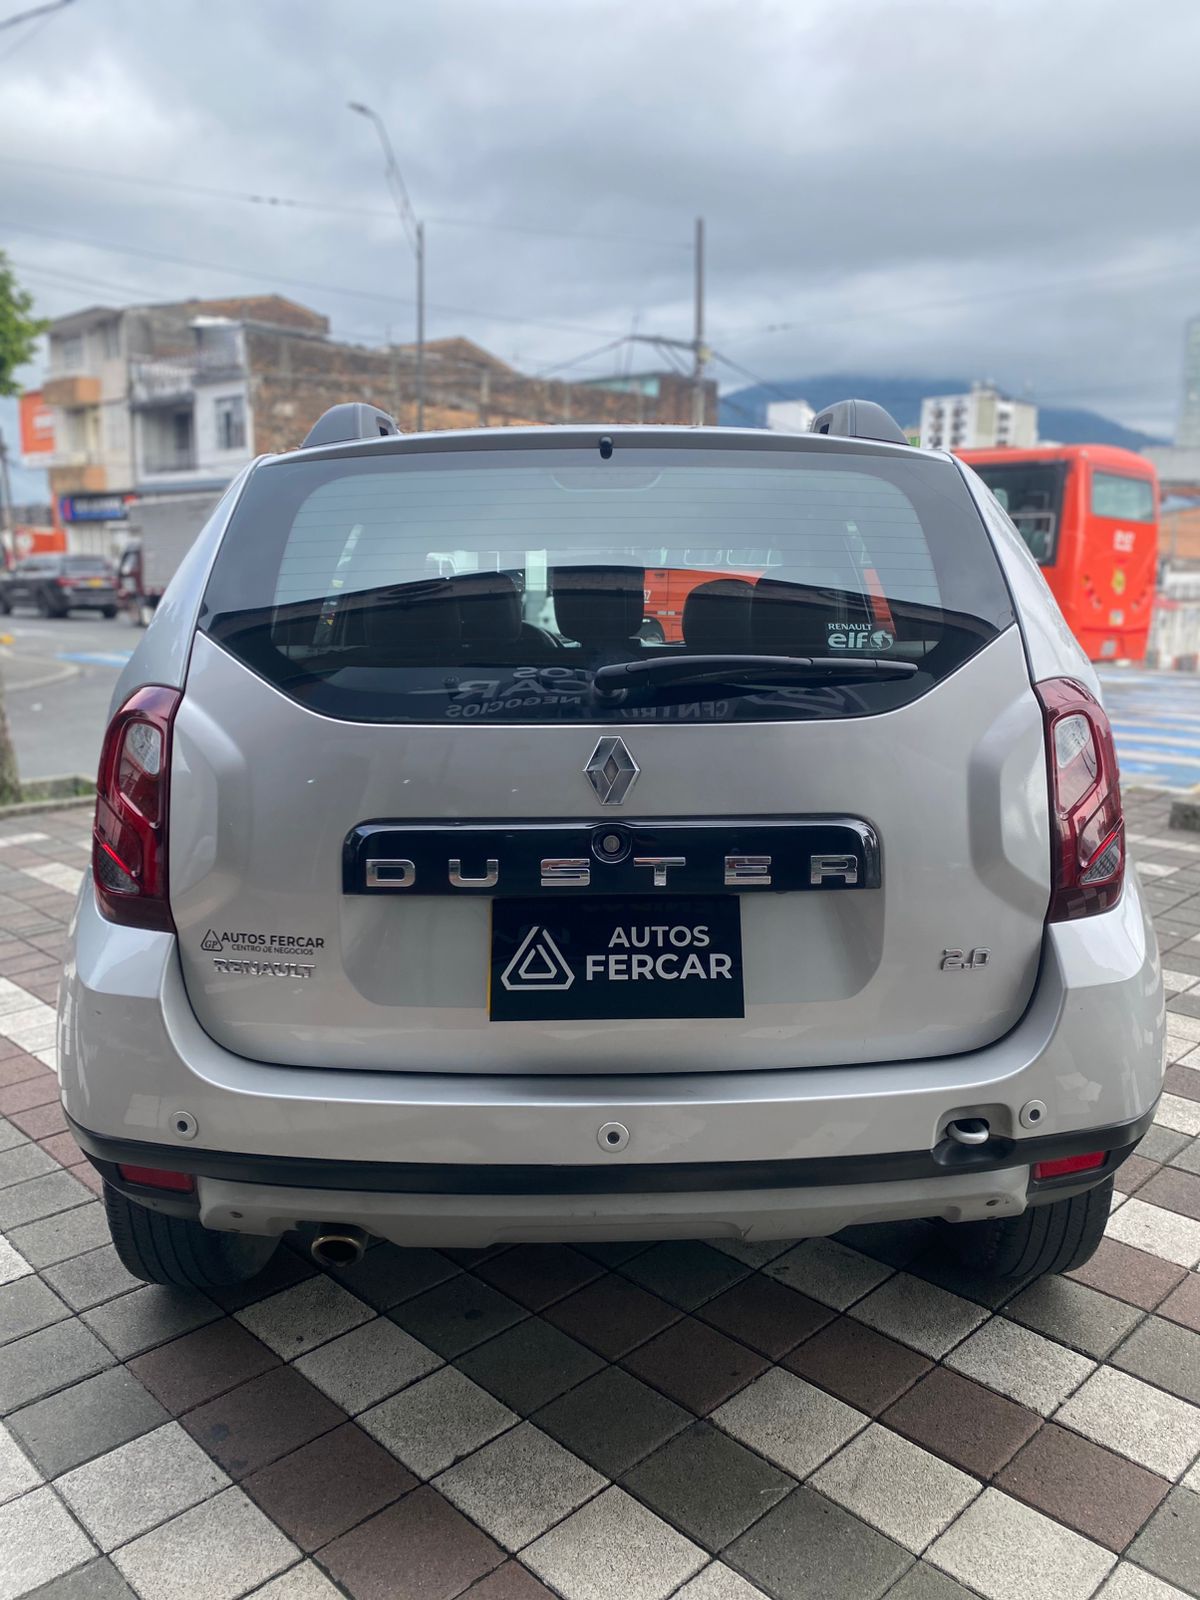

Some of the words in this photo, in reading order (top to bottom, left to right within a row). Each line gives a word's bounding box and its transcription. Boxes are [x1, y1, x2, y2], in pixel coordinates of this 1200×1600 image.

[827, 623, 873, 631] RENAULT
[827, 632, 869, 649] elf
[365, 855, 859, 888] DUSTER
[221, 931, 266, 945] AUTOS
[270, 935, 325, 949] FERCAR
[608, 925, 711, 949] AUTOS
[231, 943, 261, 953] CENTRO
[273, 946, 314, 956] NEGOCIOS
[940, 947, 991, 971] 2.0
[213, 957, 316, 978] RENAULT
[585, 953, 734, 981] FERCAR
